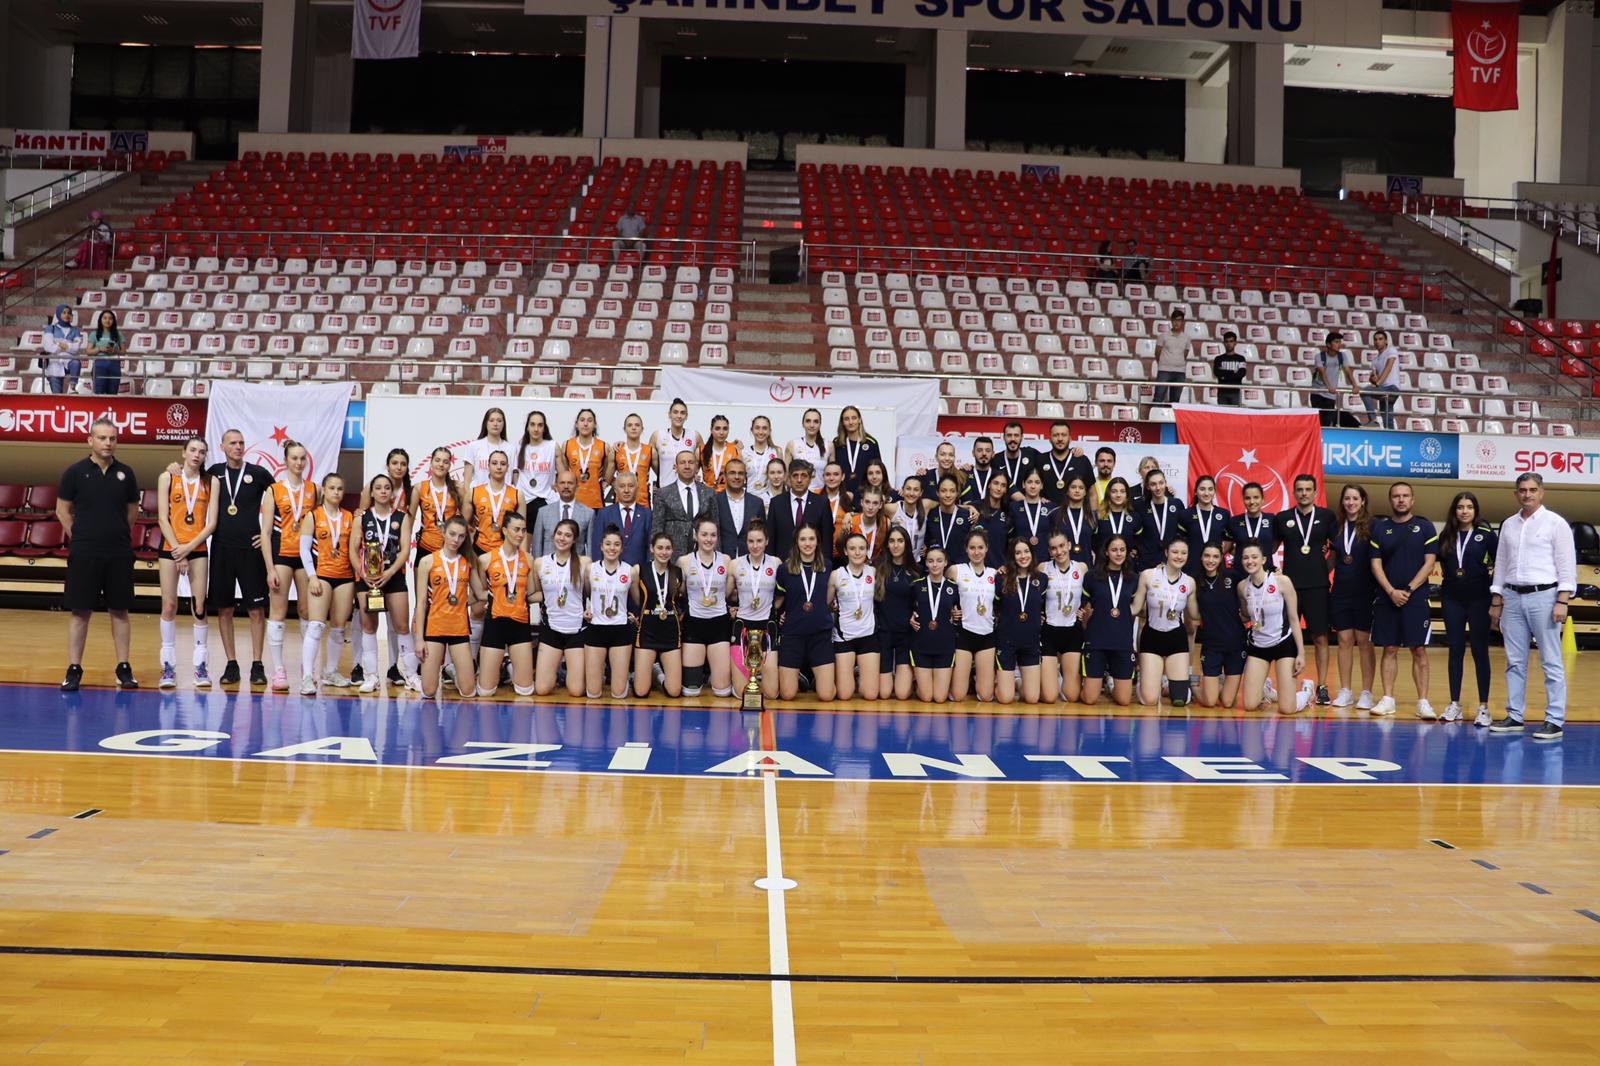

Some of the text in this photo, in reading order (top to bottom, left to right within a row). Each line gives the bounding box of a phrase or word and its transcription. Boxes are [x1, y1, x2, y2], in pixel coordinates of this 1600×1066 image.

[369, 16, 401, 31] TVF
[1082, 0, 1302, 32] SALONU
[1470, 67, 1501, 84] TVF
[15, 133, 105, 150] KANTİN
[798, 386, 832, 400] TVF
[98, 729, 1402, 782] GAZİANTEP
